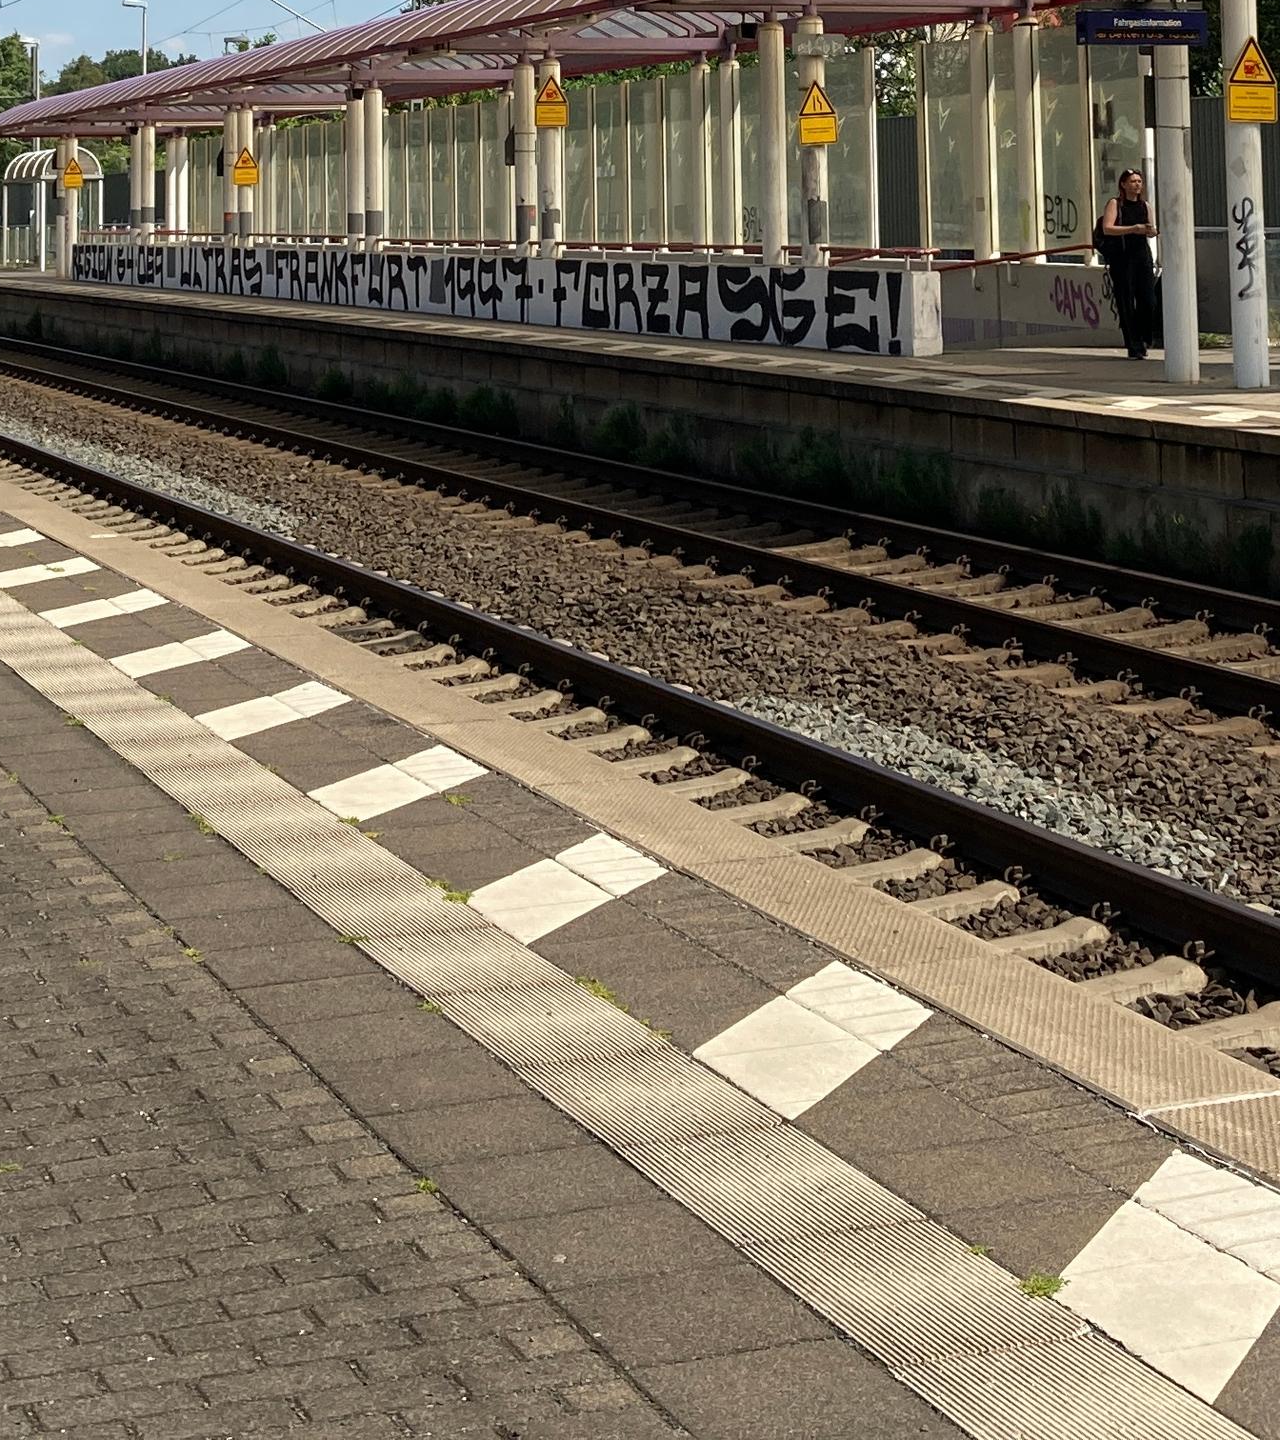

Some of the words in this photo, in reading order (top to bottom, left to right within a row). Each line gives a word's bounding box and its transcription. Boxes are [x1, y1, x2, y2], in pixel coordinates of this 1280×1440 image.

[1113, 18, 1182, 28] Fahrgastinformation
[180, 247, 262, 296] ULTRAS
[275, 250, 428, 310] FRANKFURT
[552, 259, 709, 340] FORZA
[716, 264, 903, 356] SGE!
